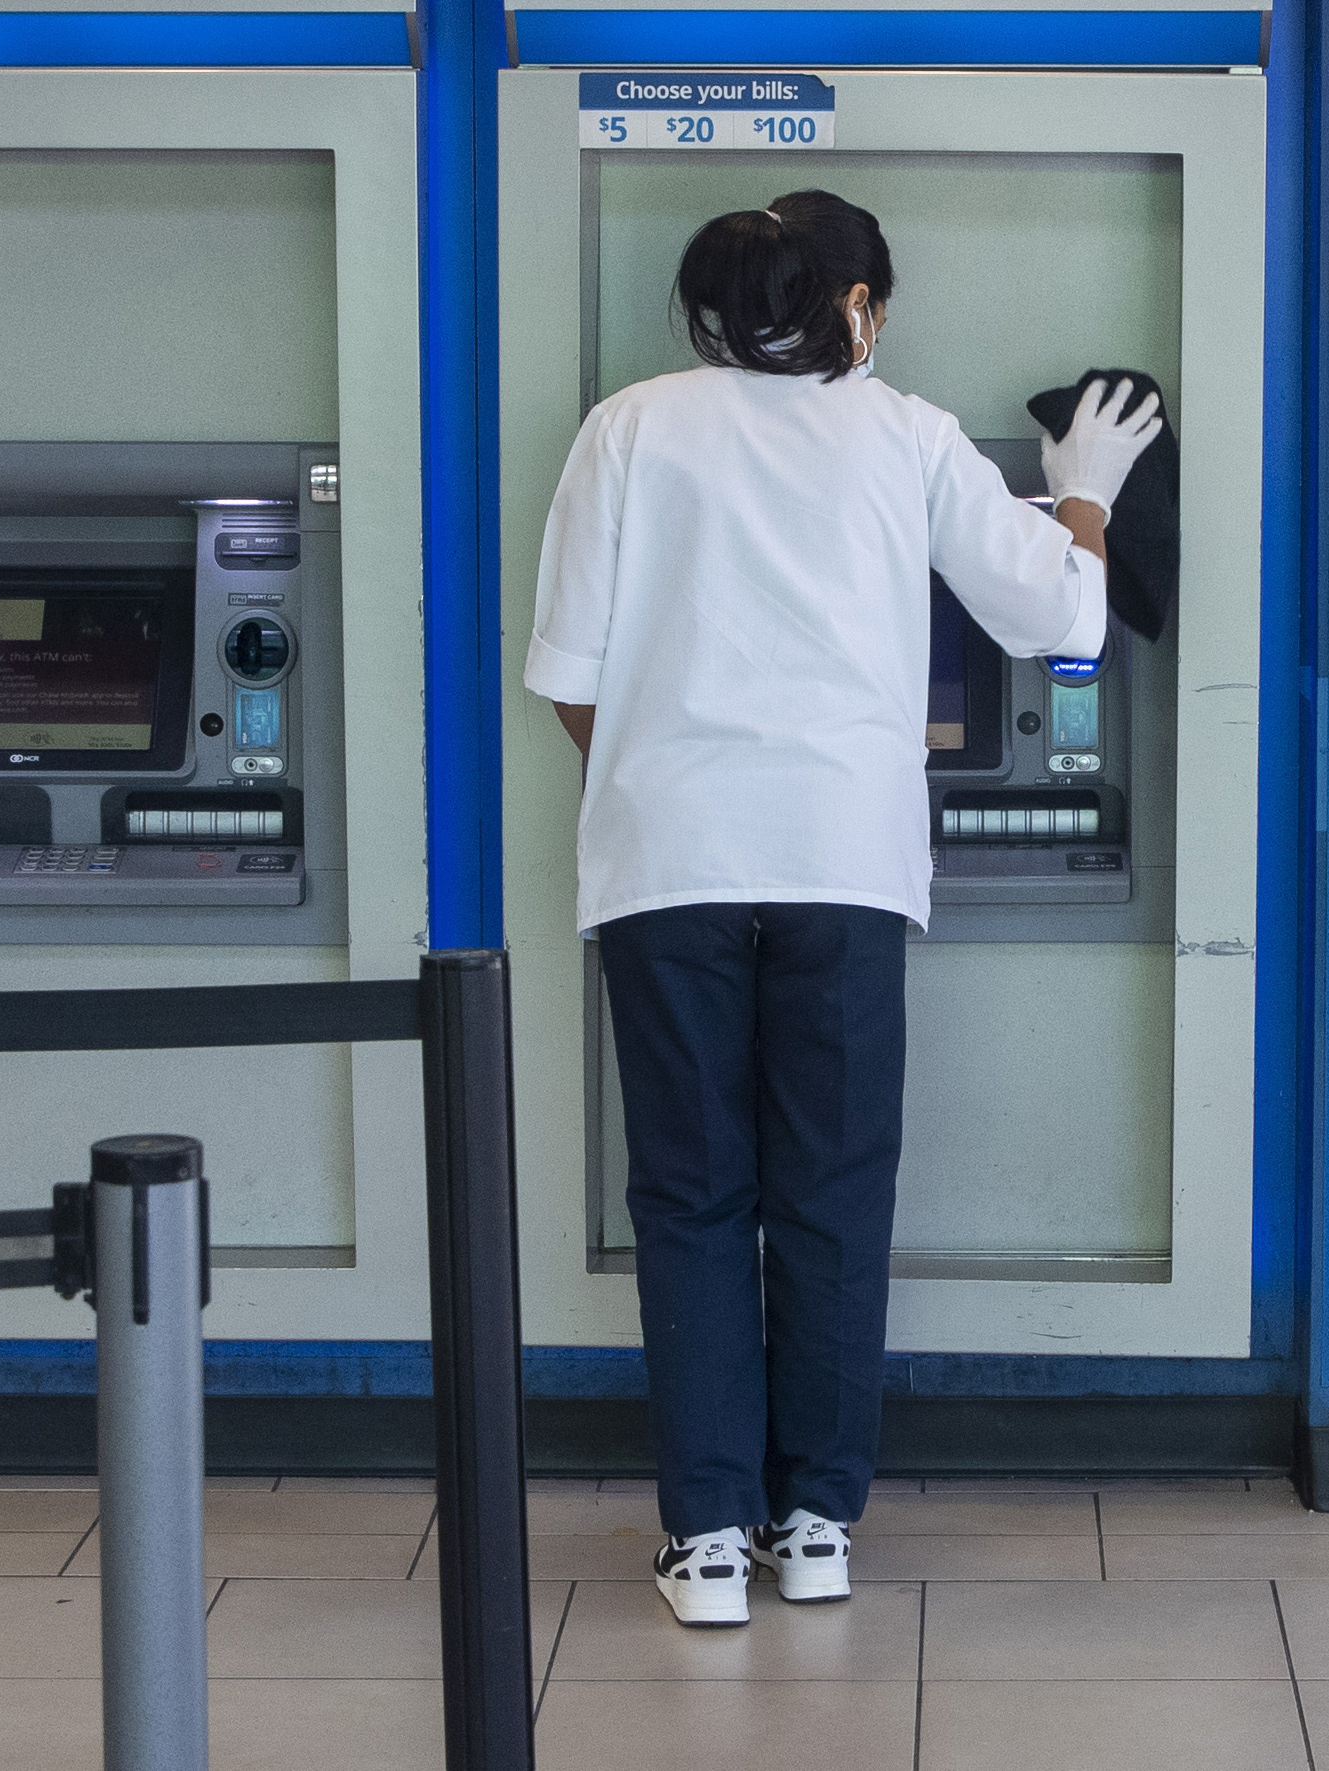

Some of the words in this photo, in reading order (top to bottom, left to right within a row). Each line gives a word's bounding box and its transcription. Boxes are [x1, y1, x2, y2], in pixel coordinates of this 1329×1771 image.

[616, 81, 693, 100] Choose
[697, 83, 746, 104] your
[751, 80, 799, 100] bills:
[598, 116, 628, 143] $5
[666, 116, 715, 143] $20
[753, 116, 816, 143] $100
[10, 652, 31, 662] this
[33, 652, 59, 662] ATM
